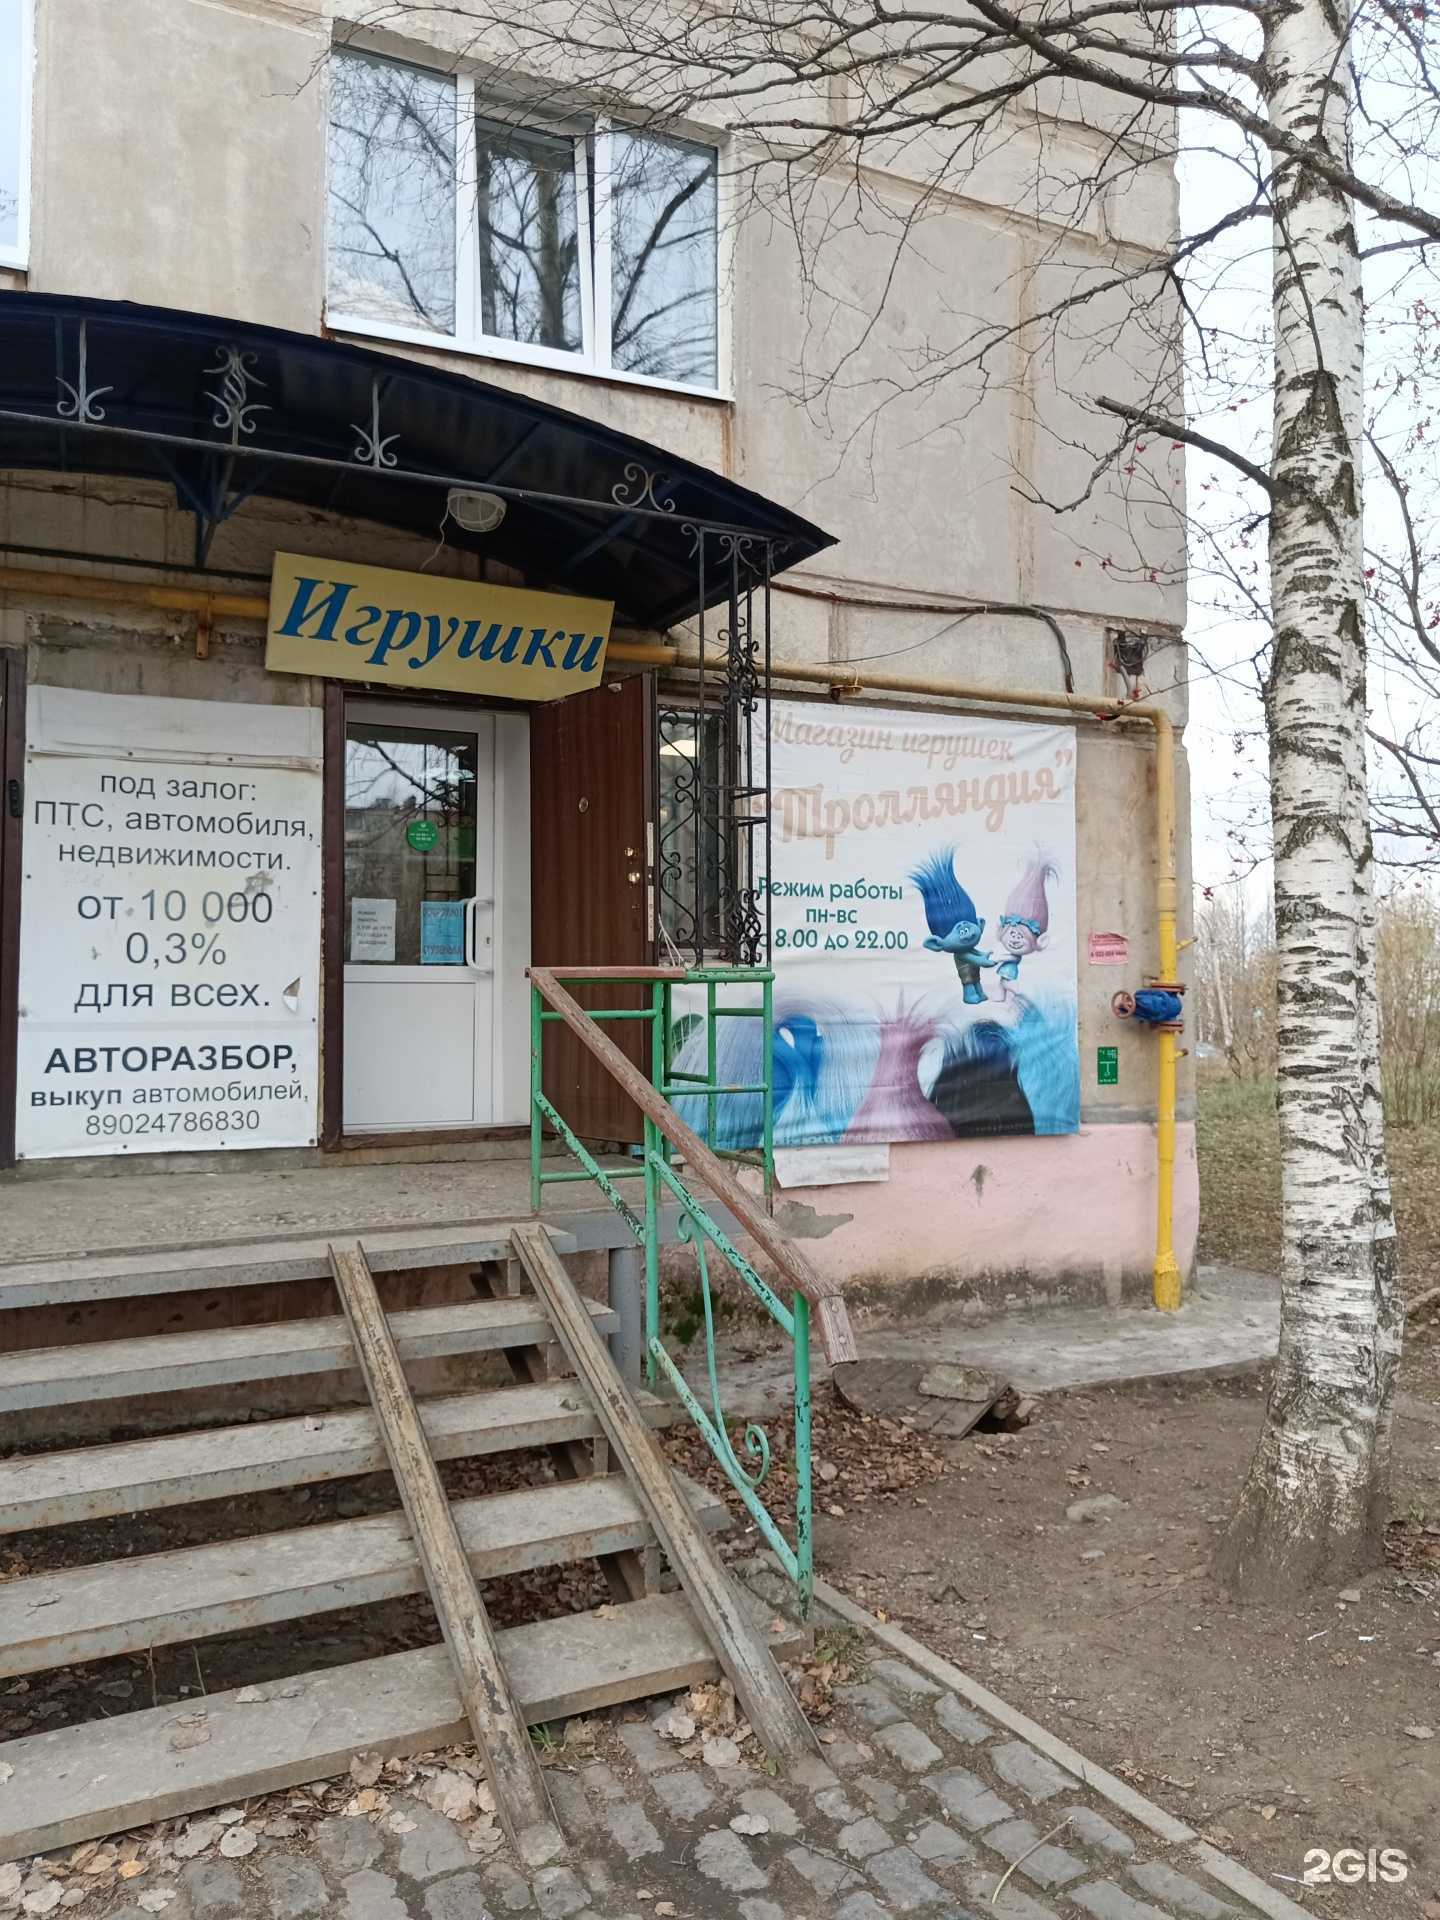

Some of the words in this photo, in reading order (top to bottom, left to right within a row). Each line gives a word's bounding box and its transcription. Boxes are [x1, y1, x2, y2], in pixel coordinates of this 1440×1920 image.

[273, 576, 605, 673] Игрушки
[760, 709, 895, 764] Магазин
[900, 731, 1016, 770] игрушек
[100, 774, 156, 799] под
[166, 778, 257, 801] залог:
[34, 800, 113, 832] ПТС,
[125, 811, 315, 841] автомобиля,
[58, 843, 292, 871] недвижимости.
[758, 876, 824, 899] Режим
[829, 877, 903, 903] работы
[77, 895, 124, 920] от
[141, 889, 187, 922] 10
[201, 890, 273, 924] 000
[806, 908, 858, 924] пн-вс
[126, 931, 227, 970] 0,3%
[774, 928, 818, 948] 8.00
[824, 934, 849, 951] до
[854, 930, 909, 950] 22.00
[74, 983, 153, 1014] для
[171, 983, 270, 1007] всех.
[44, 1044, 298, 1074] АВТОРАЗБОР,
[31, 1088, 122, 1110] выкуп
[132, 1080, 309, 1104] автомобилей,
[85, 1109, 261, 1136] 89024786830
